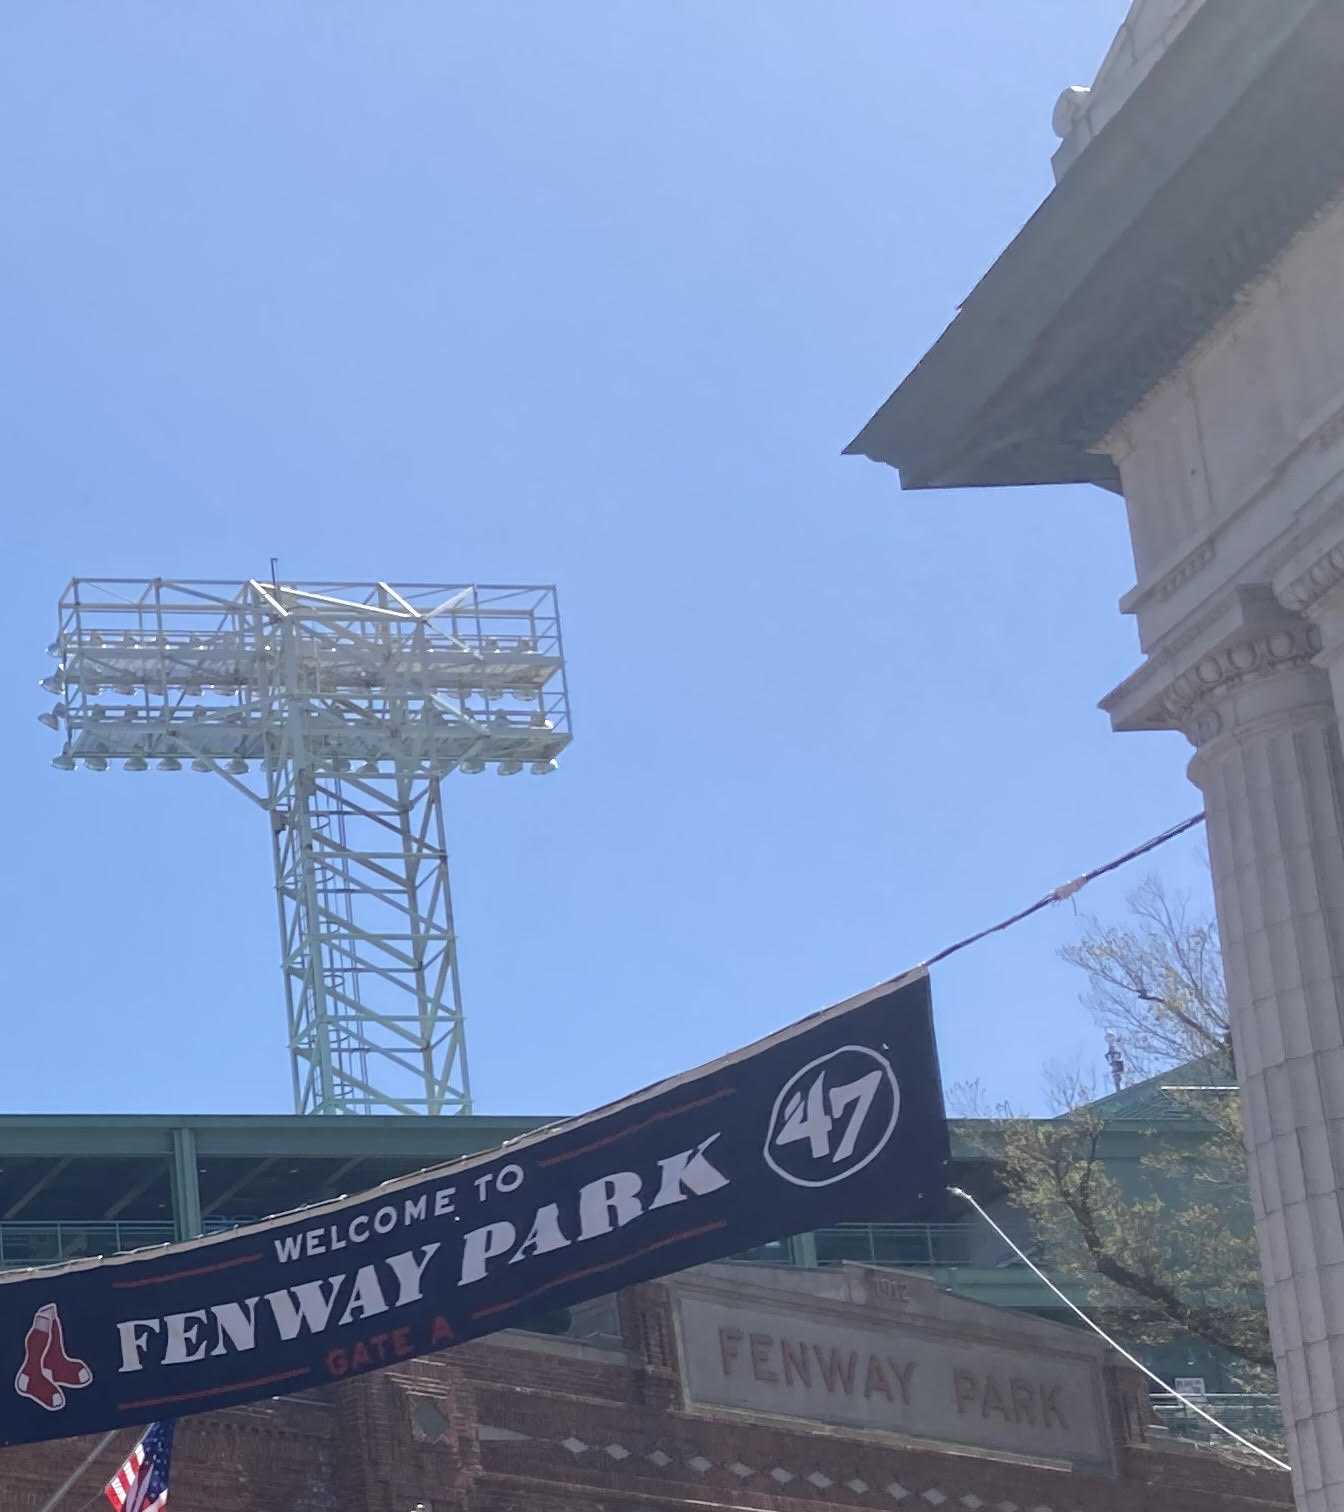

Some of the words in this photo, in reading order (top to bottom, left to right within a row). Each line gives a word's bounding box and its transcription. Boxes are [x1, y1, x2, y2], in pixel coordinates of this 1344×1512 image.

[116, 1242, 441, 1373] FENWAY
[457, 1132, 730, 1287] PARK
[274, 1187, 456, 1263] WELCOME
[474, 1164, 524, 1203] TO
[324, 1327, 414, 1376] GATE
[432, 1315, 455, 1345] A
[717, 1326, 918, 1407] FENWAY
[952, 1367, 1071, 1431] PARK
